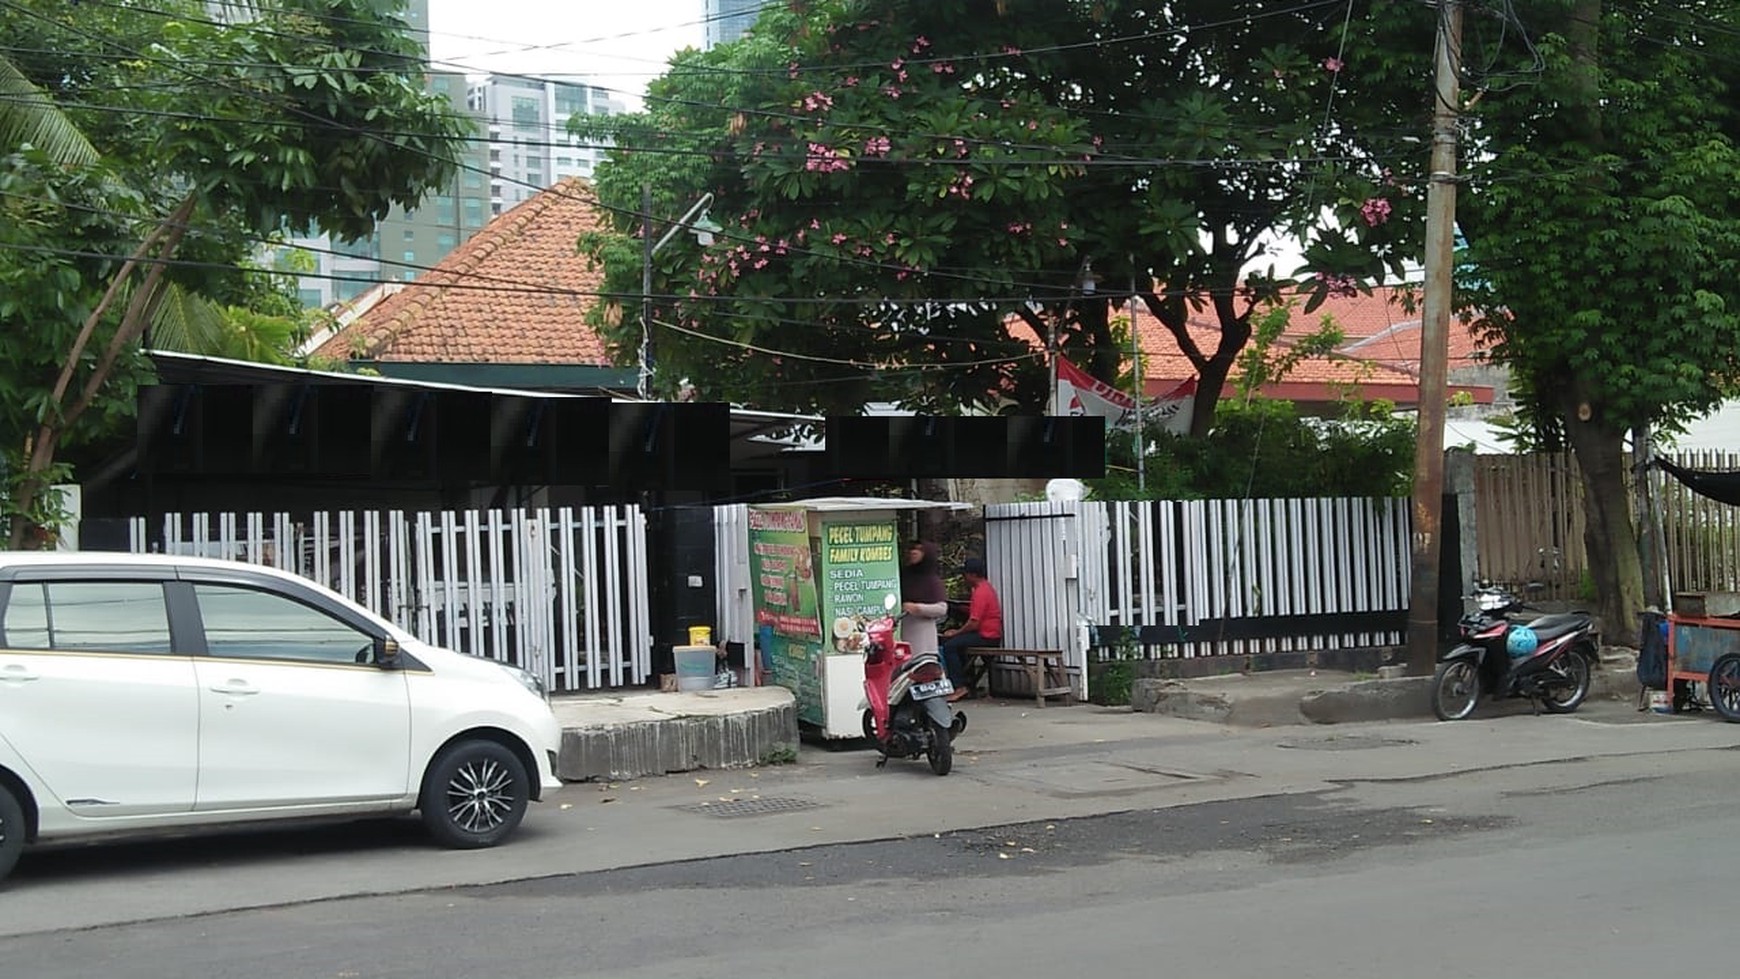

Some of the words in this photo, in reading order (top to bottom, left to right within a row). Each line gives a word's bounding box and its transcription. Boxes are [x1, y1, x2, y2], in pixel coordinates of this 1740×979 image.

[828, 526, 854, 545] PECEL
[855, 524, 894, 543] TUMPANG
[829, 547, 859, 563] FAMILY
[859, 546, 893, 562] KOMBES
[829, 569, 864, 579] SEDIA
[834, 581, 859, 591] PECEL
[861, 578, 897, 590] TUMPANG
[834, 593, 864, 603] RAWON
[857, 604, 889, 615] CAMPU
